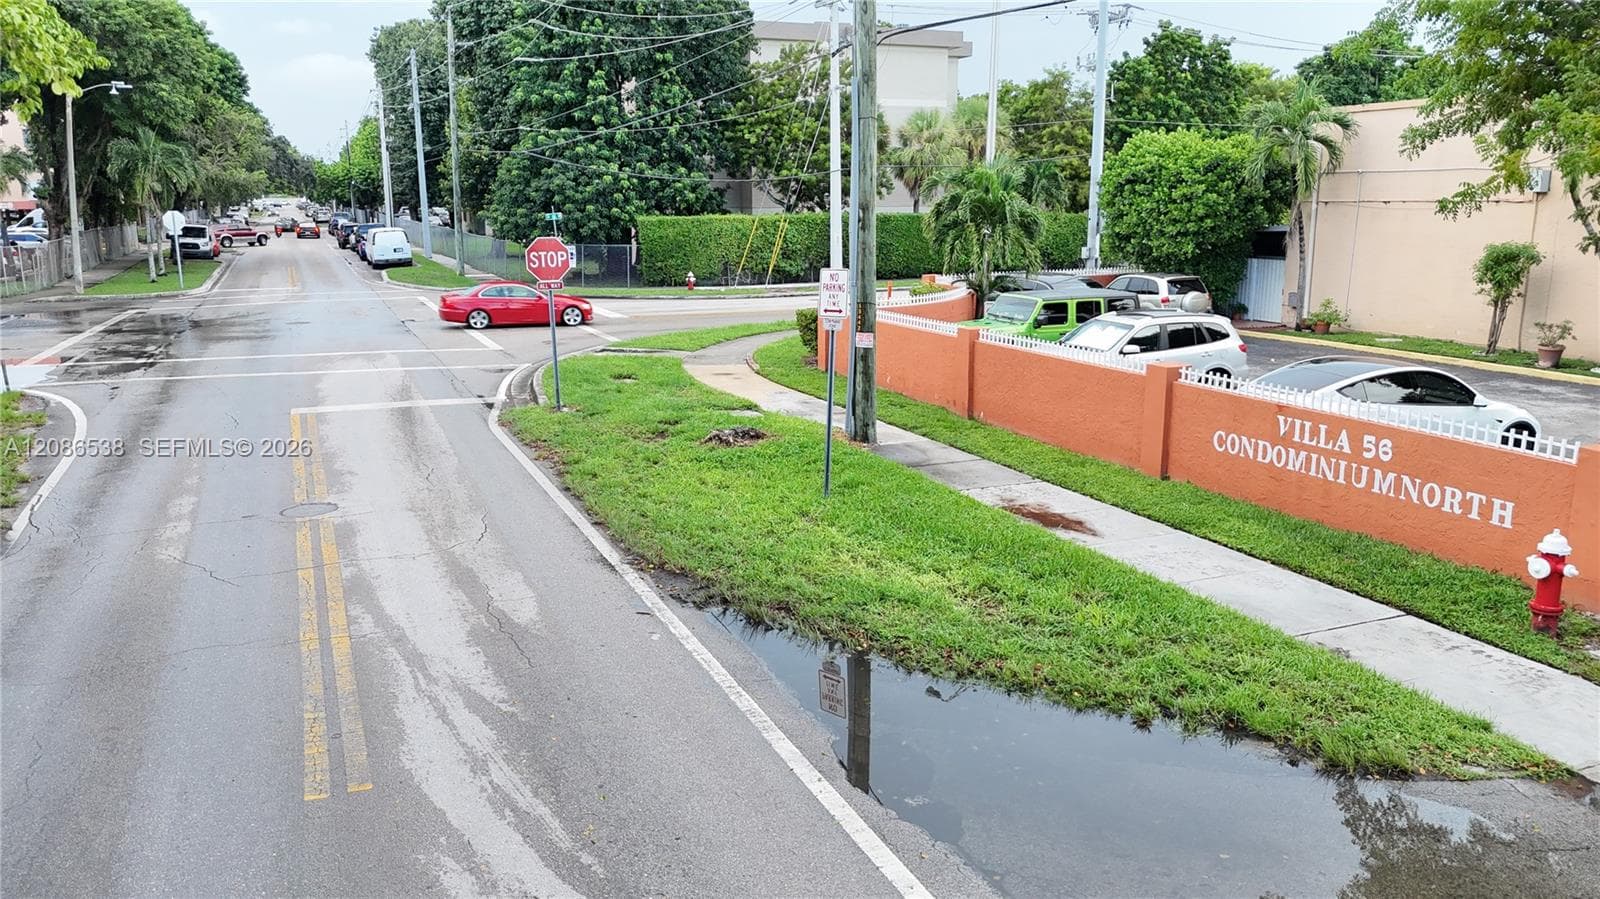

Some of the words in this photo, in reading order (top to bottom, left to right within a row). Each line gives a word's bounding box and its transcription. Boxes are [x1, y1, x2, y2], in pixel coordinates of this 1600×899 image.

[529, 251, 567, 268] STOP
[830, 273, 839, 282] NO
[822, 283, 845, 293] PARKING
[1276, 415, 1352, 454] VILLA
[1362, 435, 1393, 462] 56
